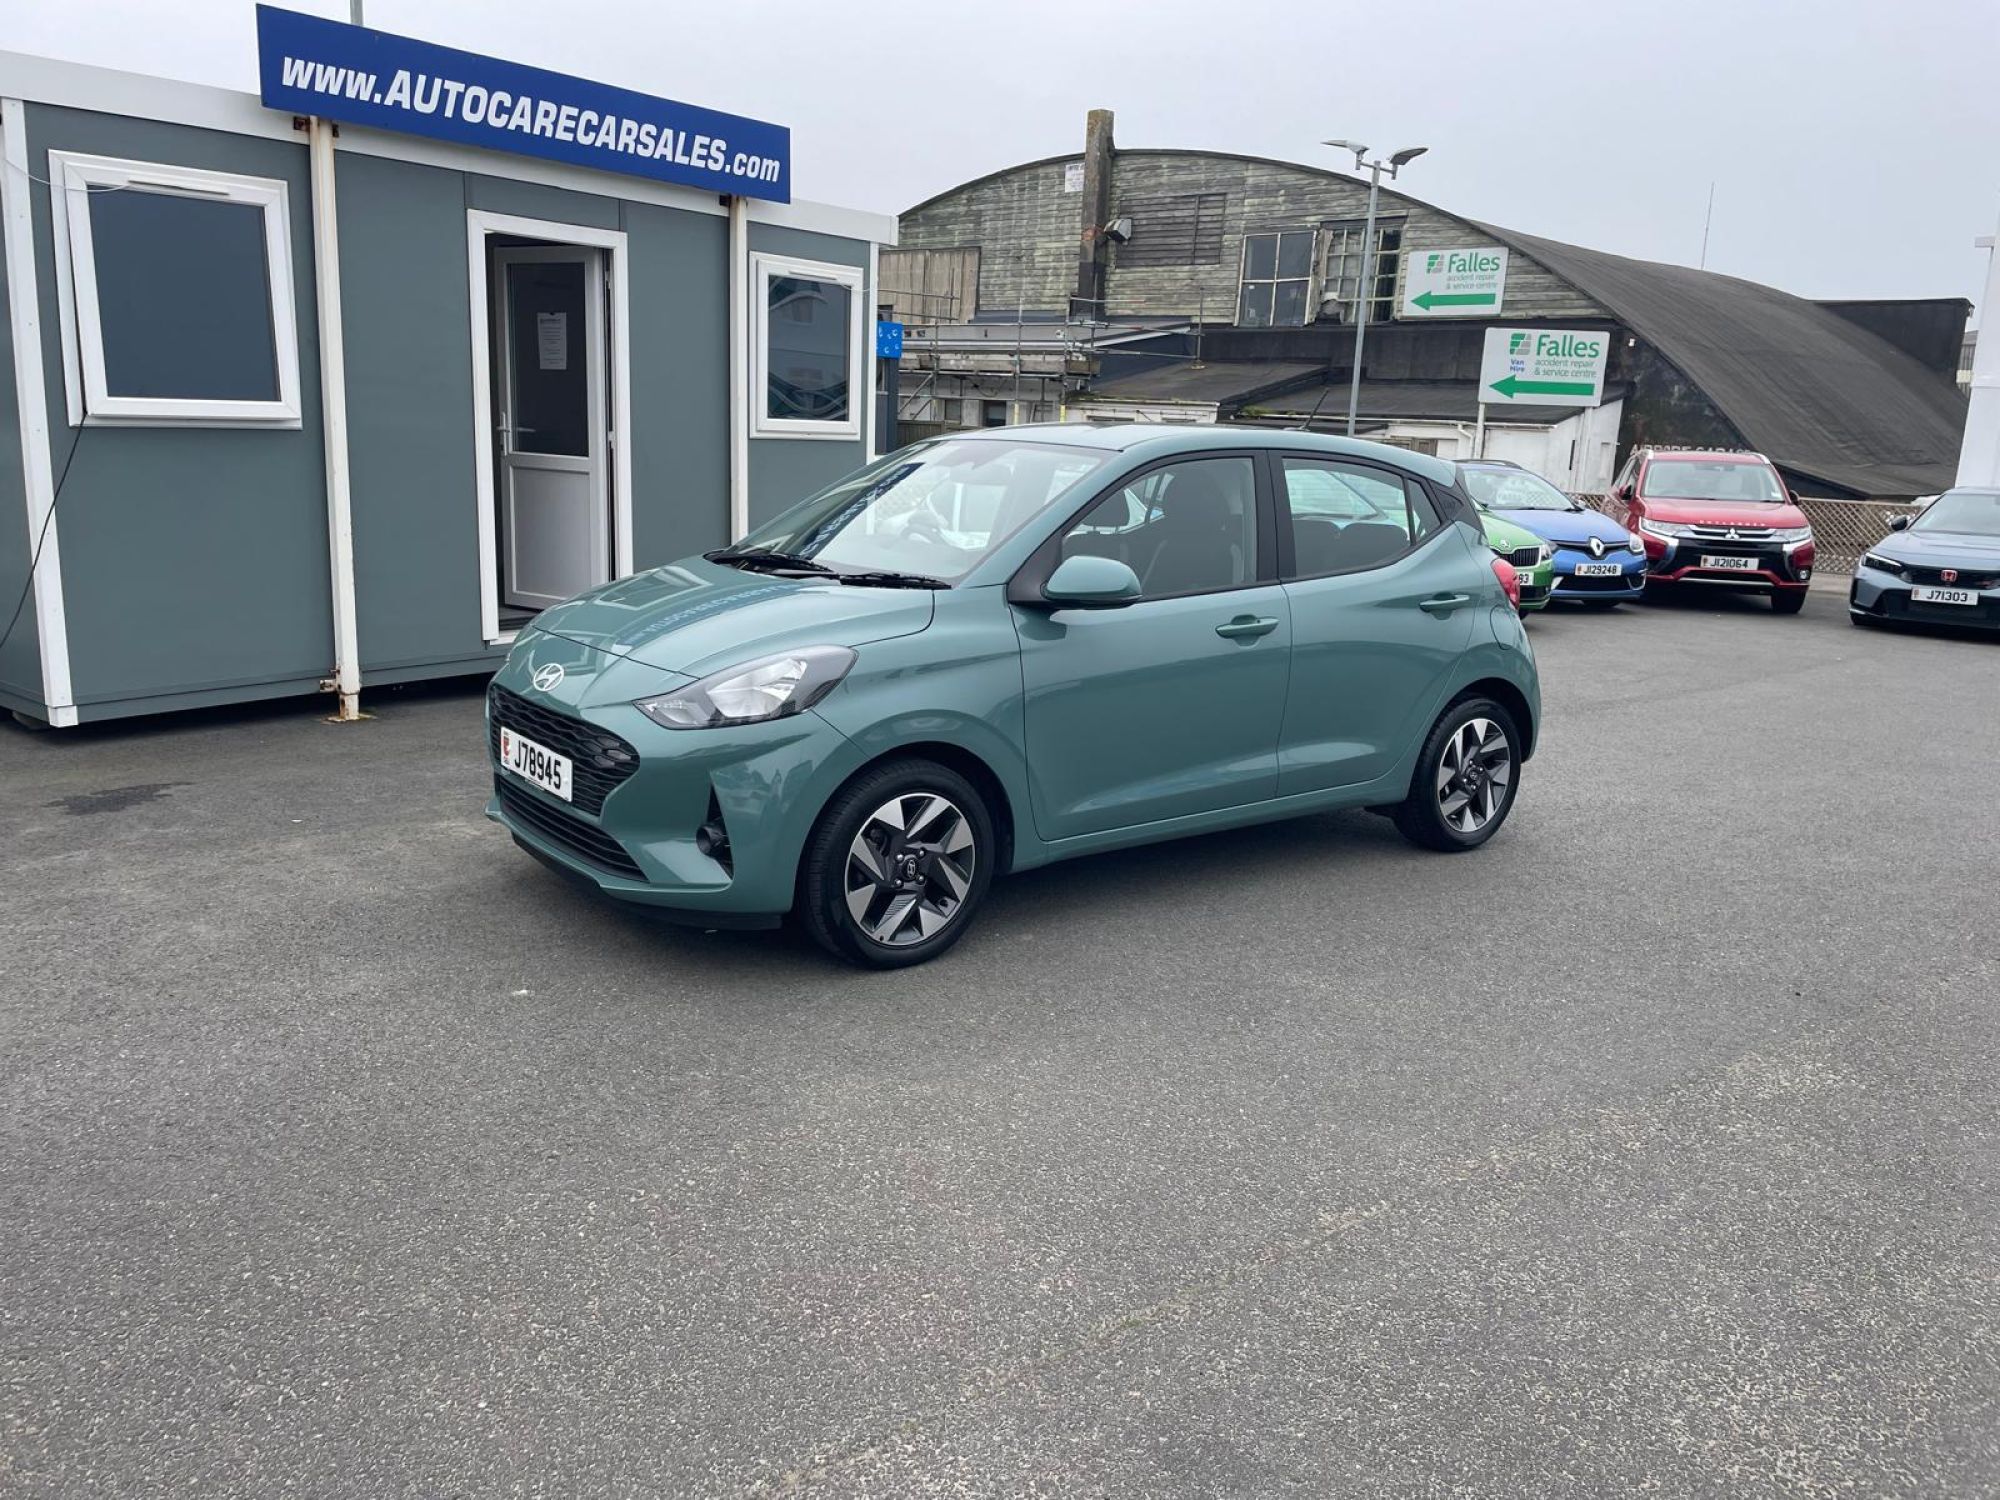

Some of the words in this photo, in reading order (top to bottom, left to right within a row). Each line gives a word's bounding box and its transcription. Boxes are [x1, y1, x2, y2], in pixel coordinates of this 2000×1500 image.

[281, 56, 781, 183] www.AUTOCARECARSALES.com
[1448, 252, 1500, 273] Falles
[1536, 334, 1600, 358] Falles
[1534, 358, 1568, 367] accident
[1571, 360, 1595, 369] repair
[1534, 367, 1540, 376] &
[1541, 368, 1568, 377] service
[1571, 369, 1597, 378] centre
[1926, 590, 1968, 602] J71303
[514, 740, 562, 790] J78945
